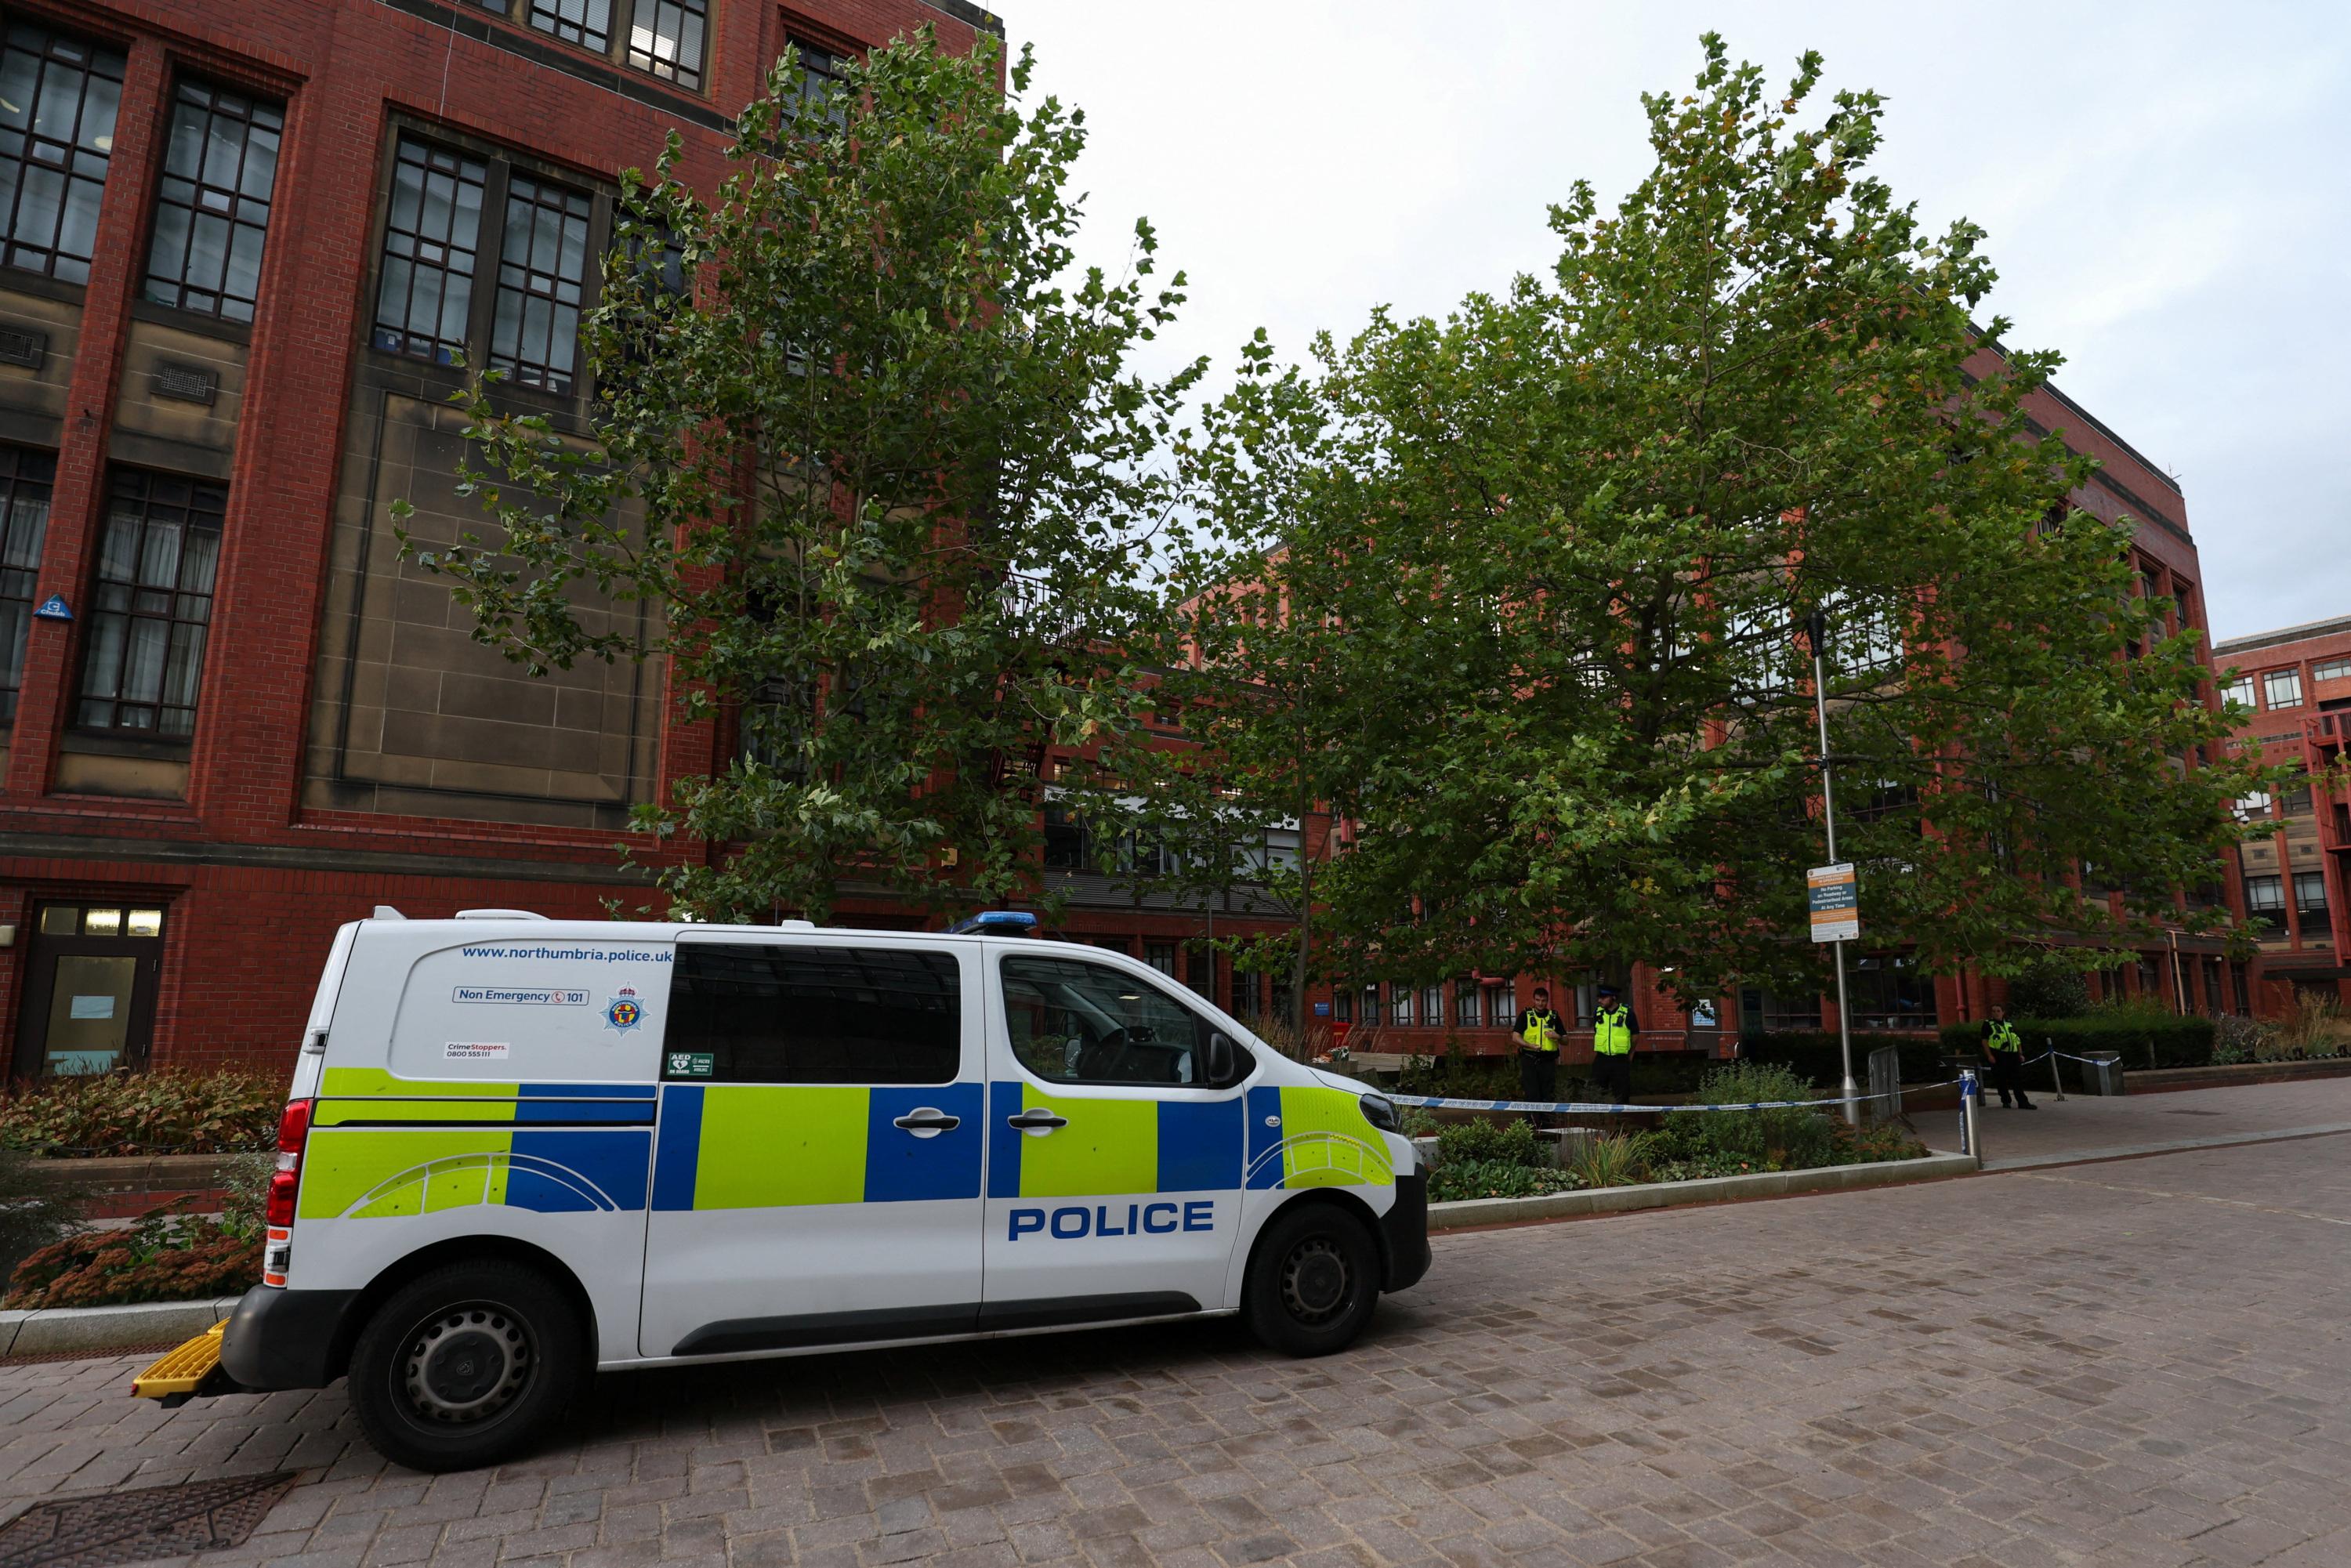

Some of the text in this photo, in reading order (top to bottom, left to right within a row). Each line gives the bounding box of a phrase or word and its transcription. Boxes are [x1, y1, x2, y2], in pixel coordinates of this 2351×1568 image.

[463, 947, 672, 963] www.northumbria.police.uk
[459, 990, 583, 1003] Non Emergency 101
[1008, 1200, 1214, 1241] POLICE
